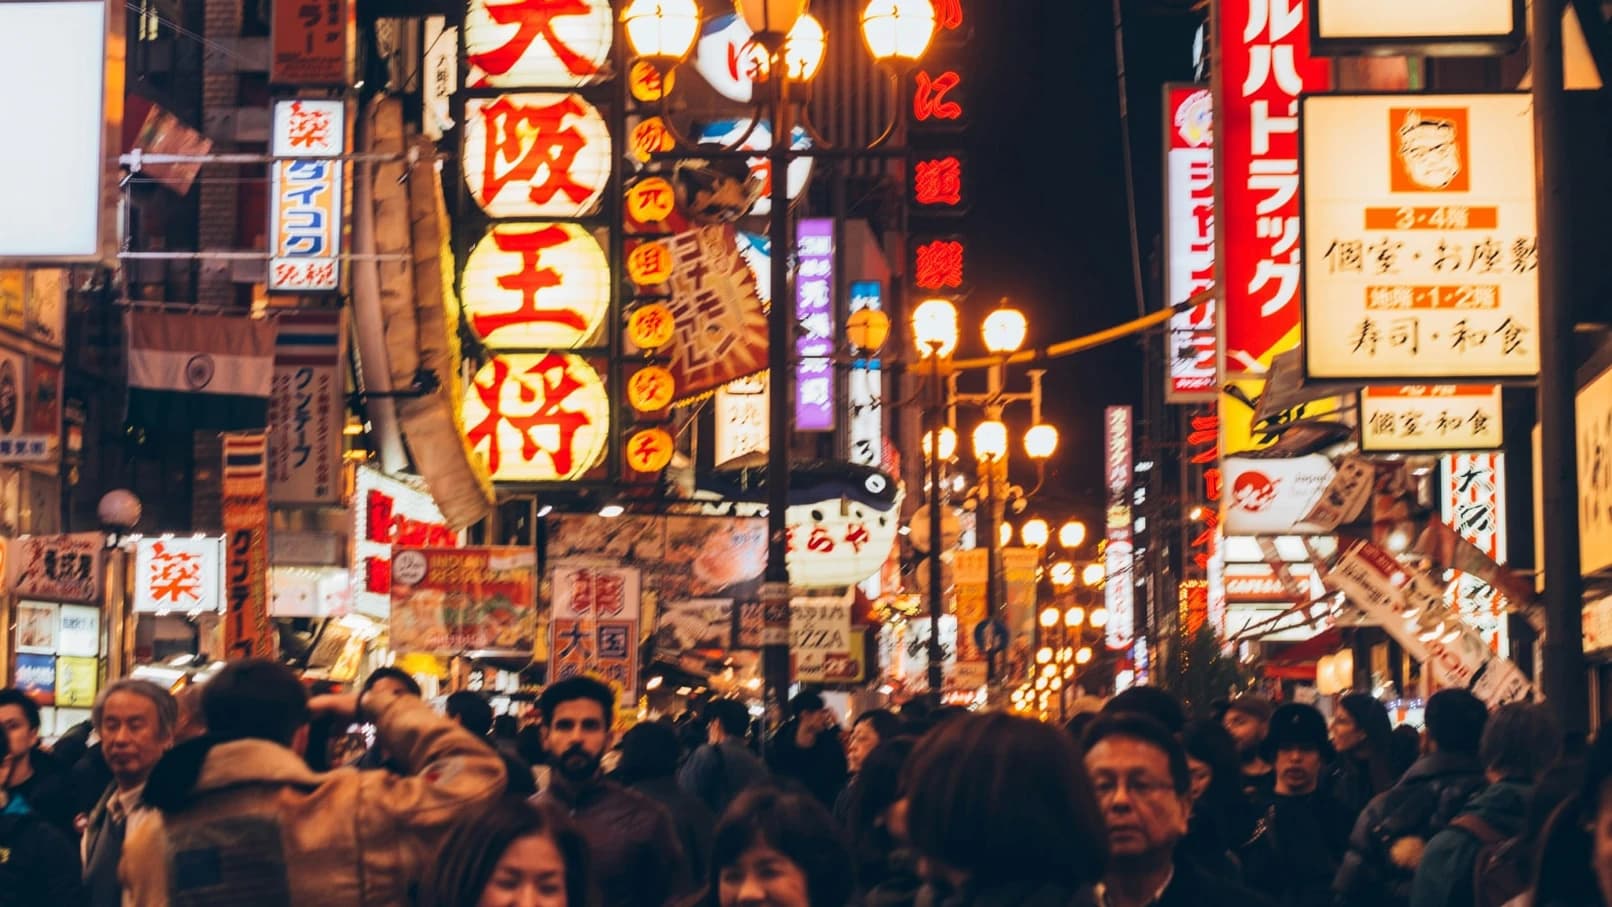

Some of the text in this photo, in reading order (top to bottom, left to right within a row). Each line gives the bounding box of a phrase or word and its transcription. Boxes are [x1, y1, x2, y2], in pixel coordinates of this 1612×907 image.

[287, 101, 331, 148] 薬
[286, 158, 325, 257] ダイコク
[1396, 206, 1468, 230] 3・4階
[466, 0, 600, 475] 大阪王将
[1325, 238, 1537, 273] 個室・お座敷
[1351, 316, 1528, 355] 寿司・和食
[1369, 409, 1490, 437] 個室・和食
[151, 541, 201, 602] 薬
